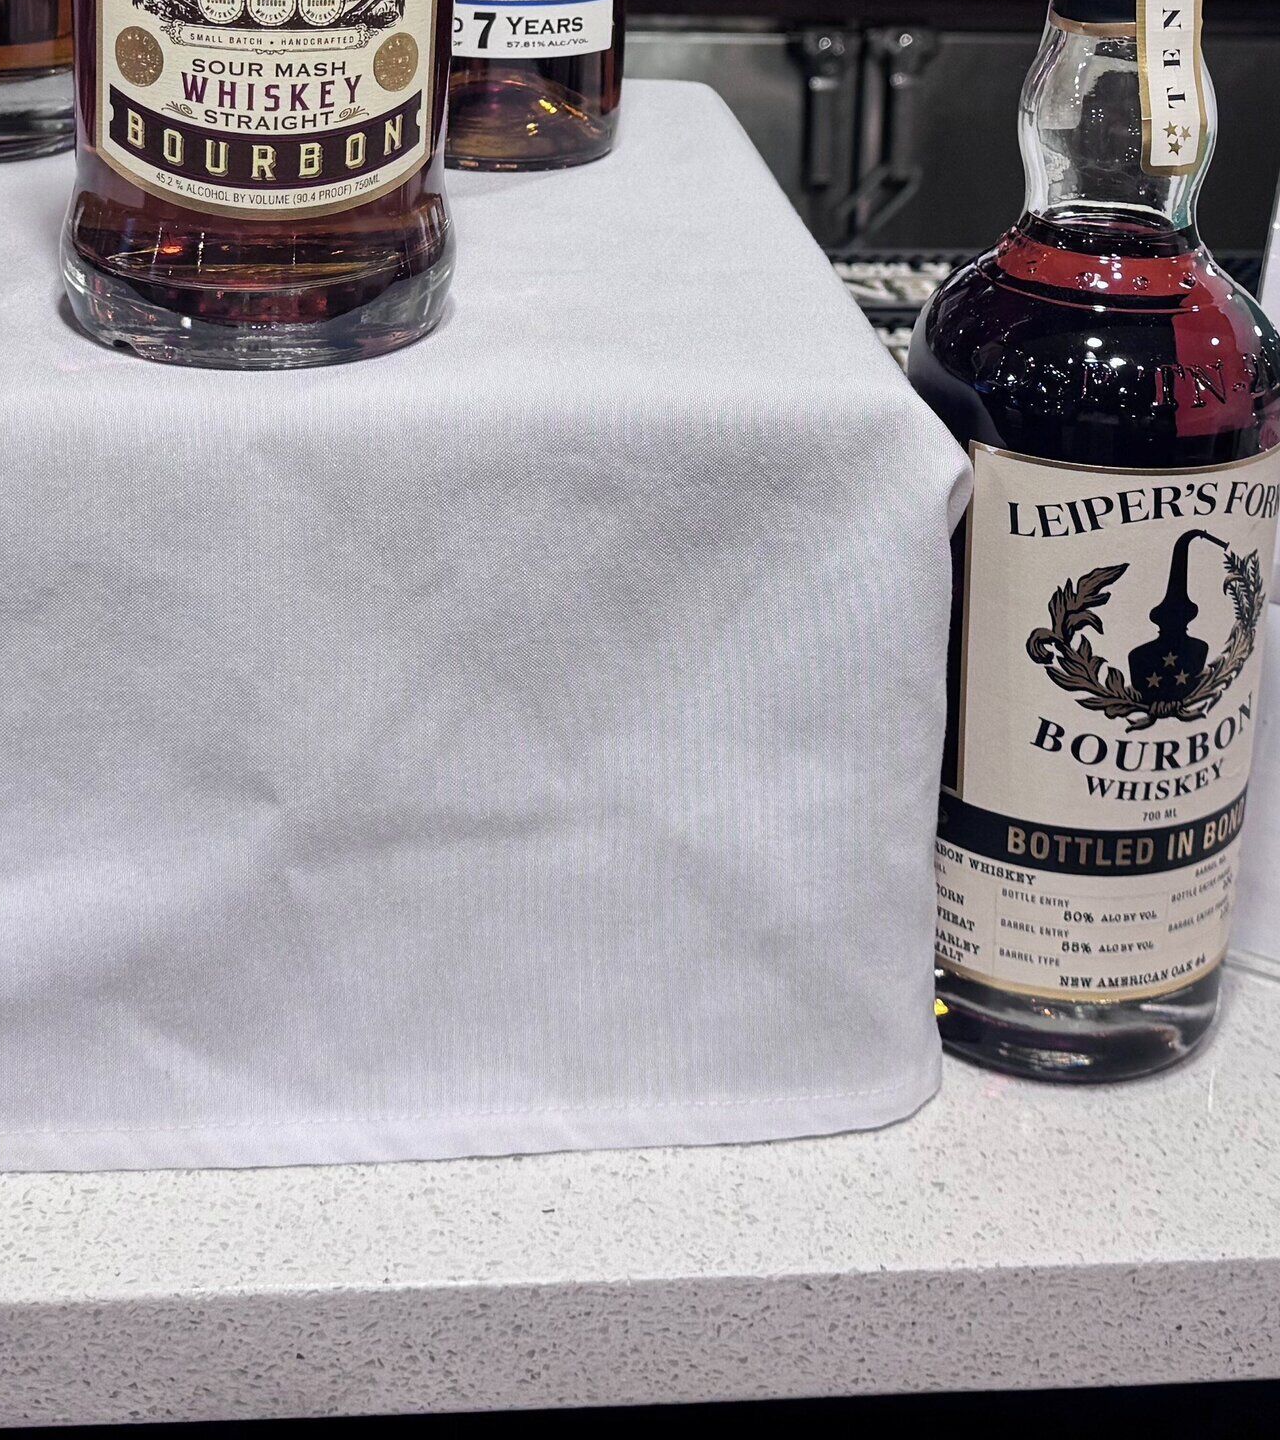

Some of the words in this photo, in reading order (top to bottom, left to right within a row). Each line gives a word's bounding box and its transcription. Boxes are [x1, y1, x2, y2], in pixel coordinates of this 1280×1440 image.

[190, 32, 223, 44] SMALL
[229, 35, 263, 46] BATCH
[280, 35, 355, 47] HANDCRAFTED
[473, 11, 497, 49] 7
[192, 58, 264, 77] SOUR
[274, 60, 347, 78] MASH
[181, 71, 363, 113] WHISKEY
[203, 108, 335, 131] STRAIGHT
[126, 107, 405, 182] BOURBON
[186, 183, 231, 202] ALCOHOL
[233, 192, 246, 204] BY
[249, 193, 290, 205] VOLUME
[319, 183, 352, 201] PROOF)
[1007, 481, 1219, 539] LEIPER'S
[1029, 691, 1254, 774] BOURBON
[1085, 757, 1225, 802] WHISKEY
[1142, 810, 1162, 822] 700
[1164, 807, 1177, 819] ML
[1007, 825, 1154, 866] BOTTLED
[1167, 827, 1195, 861] IN
[968, 857, 1037, 886] WHISKEY
[1001, 886, 1037, 905] BOTTLE
[1059, 974, 1093, 989] NEW
[1096, 968, 1169, 989] AMERICAN
